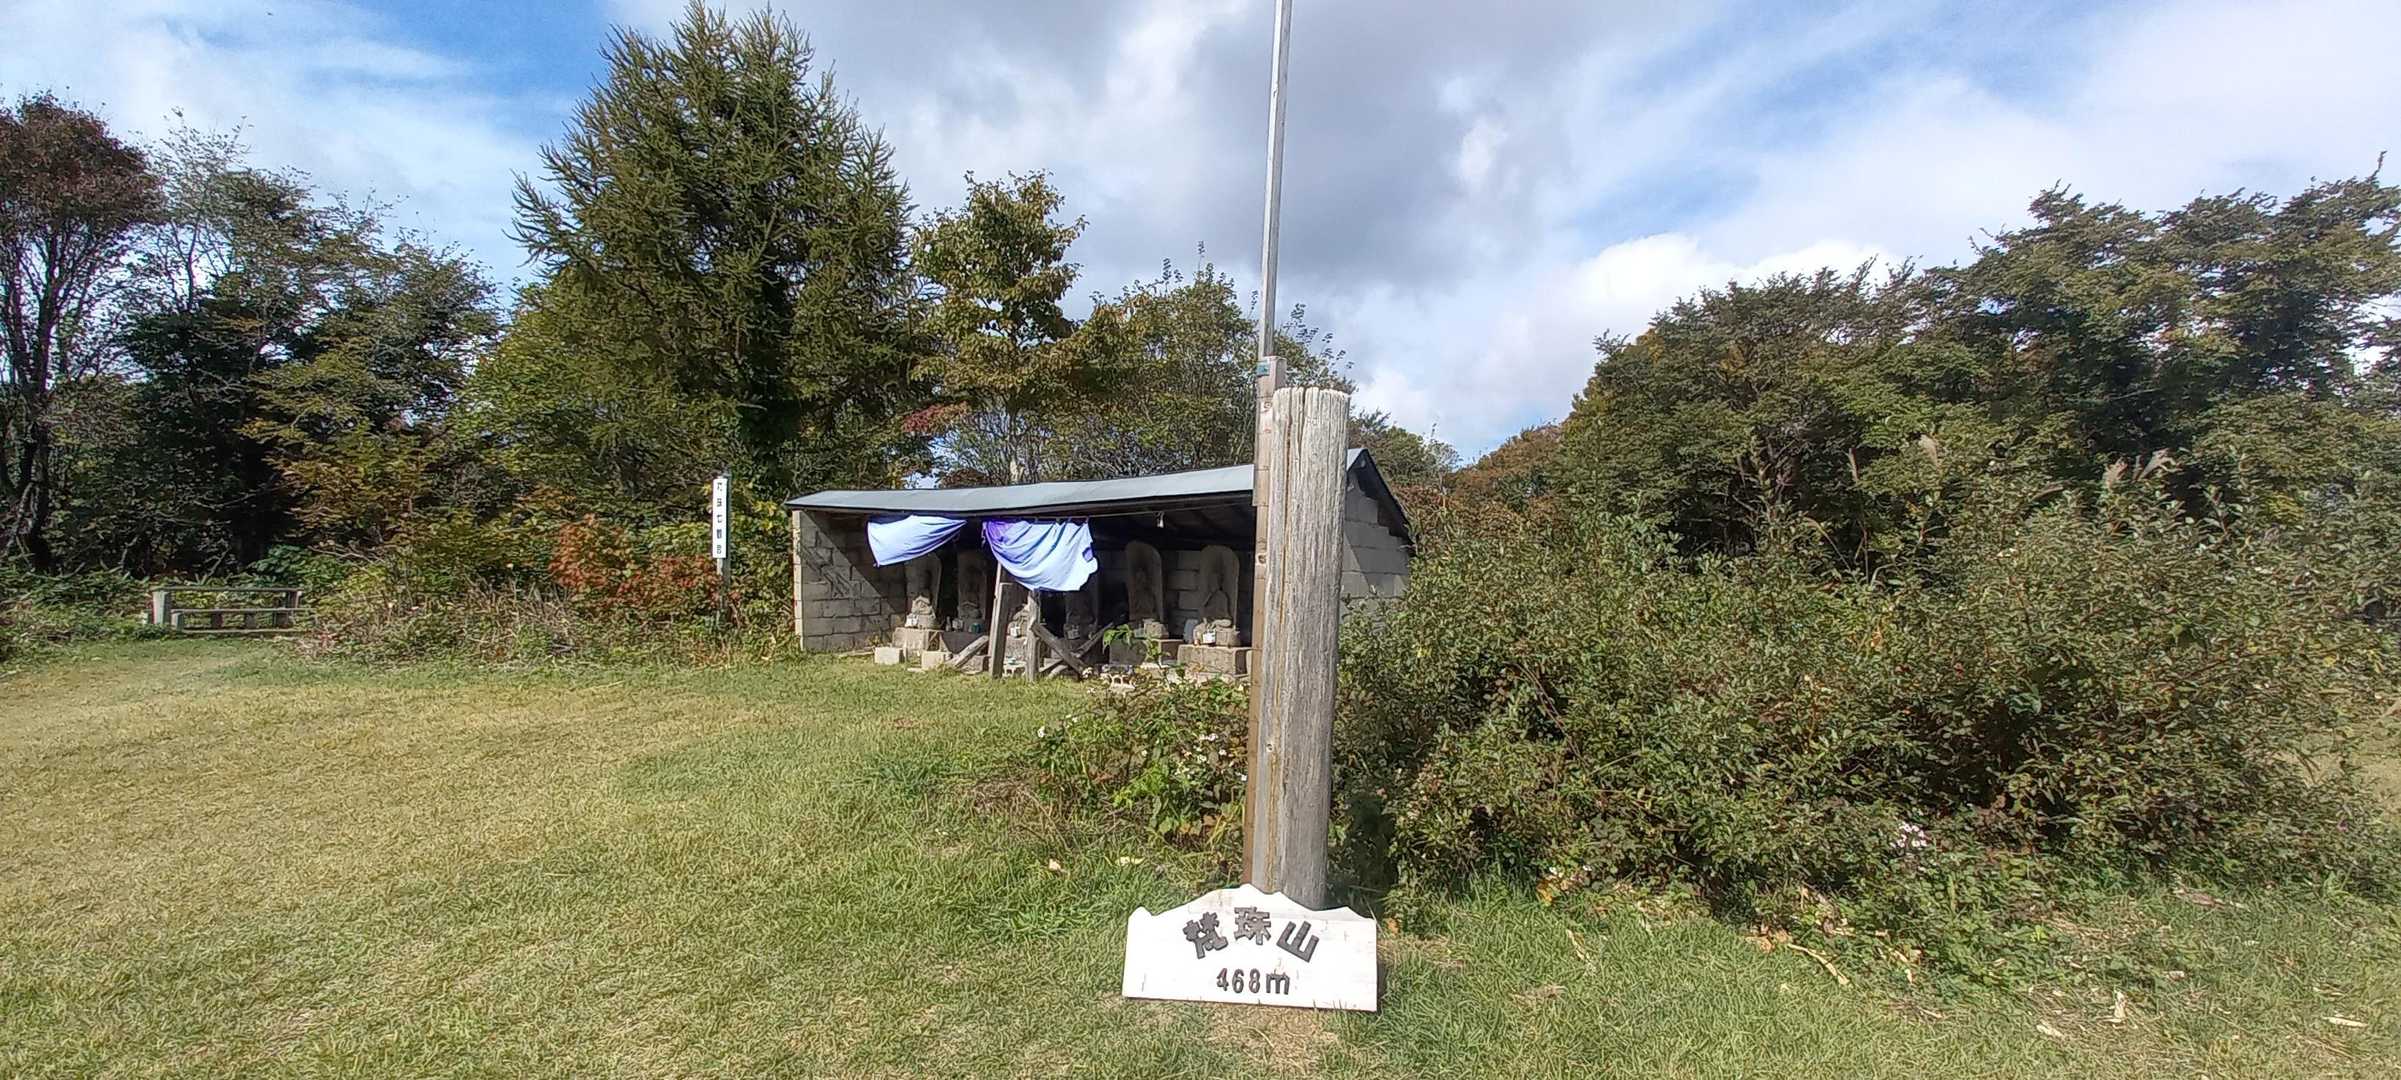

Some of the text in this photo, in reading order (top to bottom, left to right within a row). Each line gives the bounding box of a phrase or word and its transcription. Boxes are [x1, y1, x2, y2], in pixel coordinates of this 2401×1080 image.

[1182, 906, 1320, 963] 梵珠山
[1216, 967, 1290, 995] 468m
